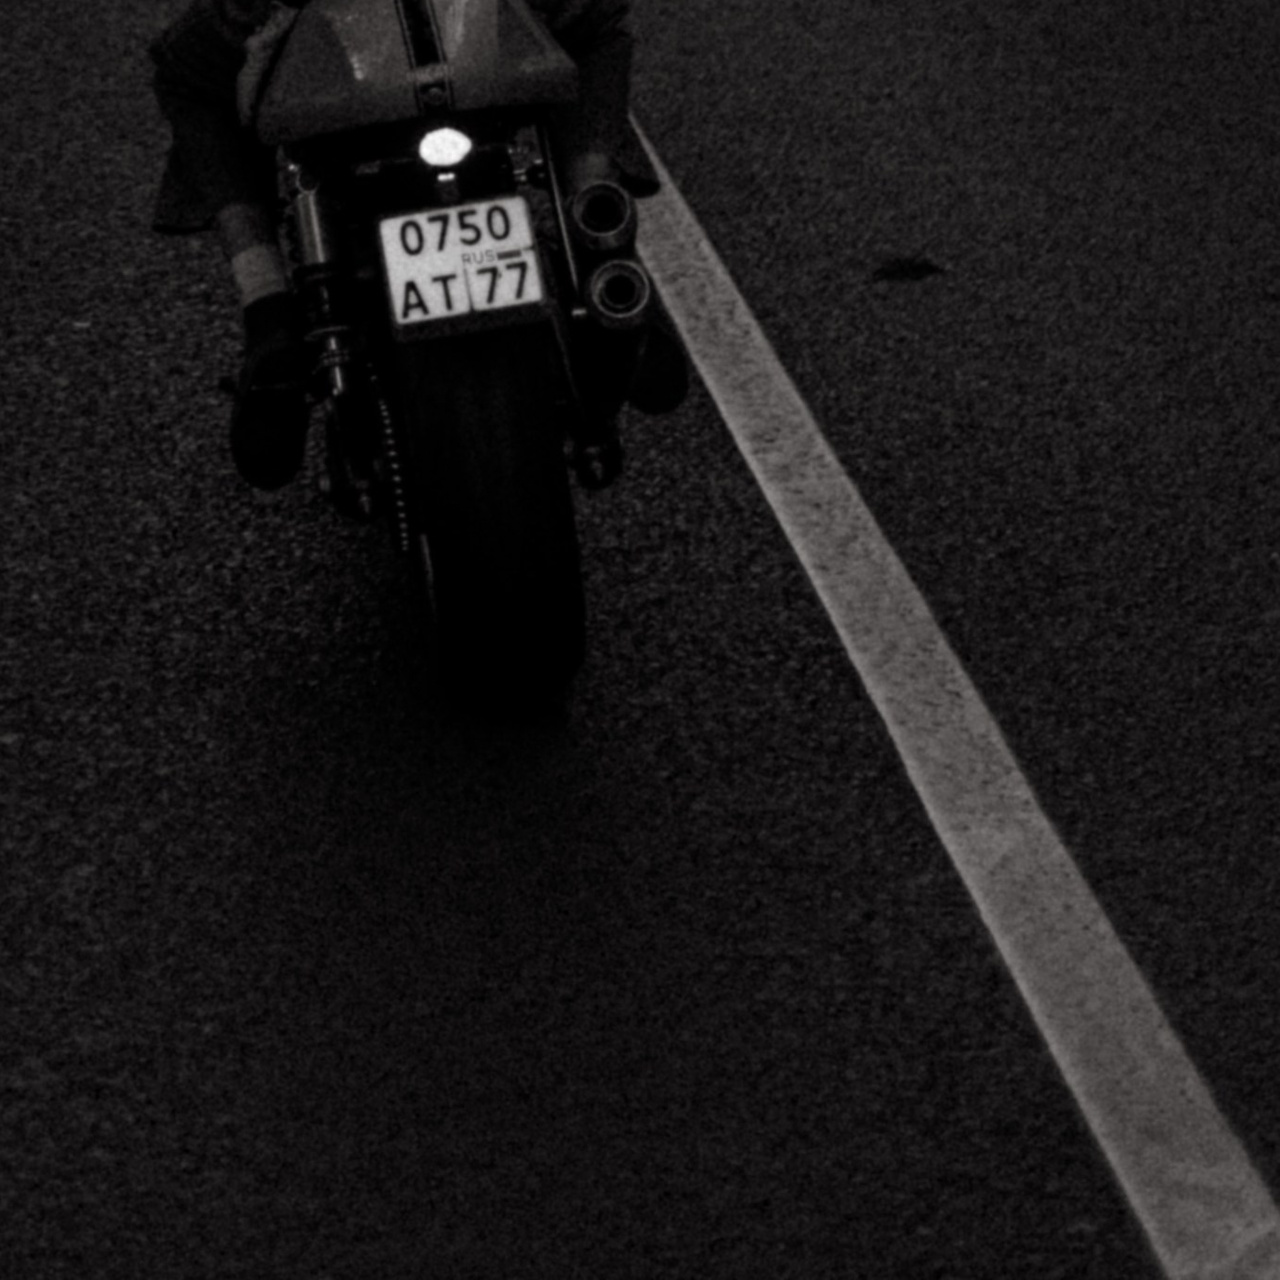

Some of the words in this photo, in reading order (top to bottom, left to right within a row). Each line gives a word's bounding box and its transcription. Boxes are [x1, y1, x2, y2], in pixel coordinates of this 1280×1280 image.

[400, 206, 510, 256] 0750
[461, 250, 495, 265] RUS
[402, 273, 457, 319] AT
[476, 261, 528, 305] 77
